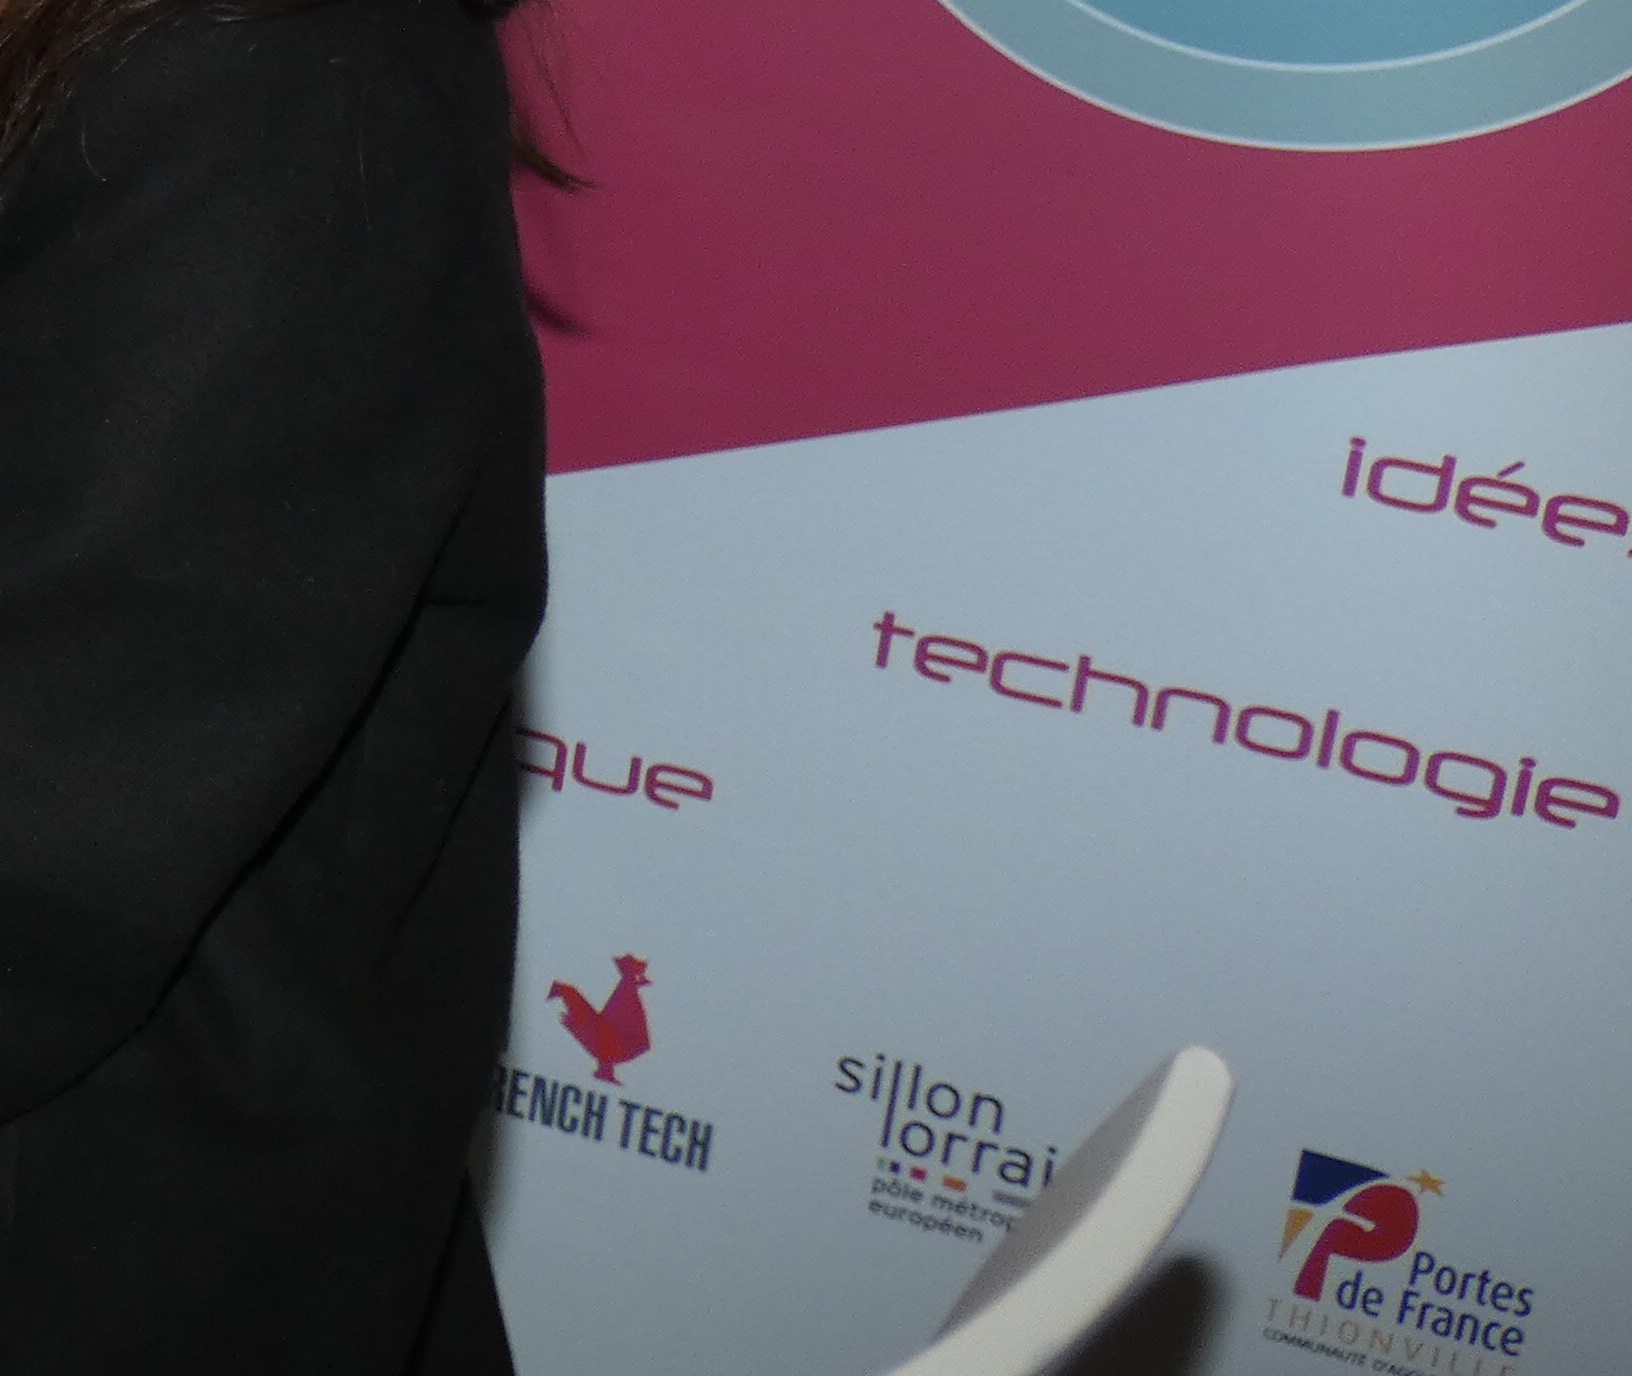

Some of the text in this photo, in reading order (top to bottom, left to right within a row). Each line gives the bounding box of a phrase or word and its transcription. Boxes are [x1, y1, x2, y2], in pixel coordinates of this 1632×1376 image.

[1341, 435, 1632, 558] idée
[872, 611, 1621, 829] technologie
[618, 1098, 715, 1174] TECH
[834, 1052, 1005, 1139] sillon
[867, 1198, 985, 1244] européen
[871, 1176, 925, 1203] pôle
[1336, 1270, 1525, 1357] de France
[1408, 1250, 1535, 1318] Portes
